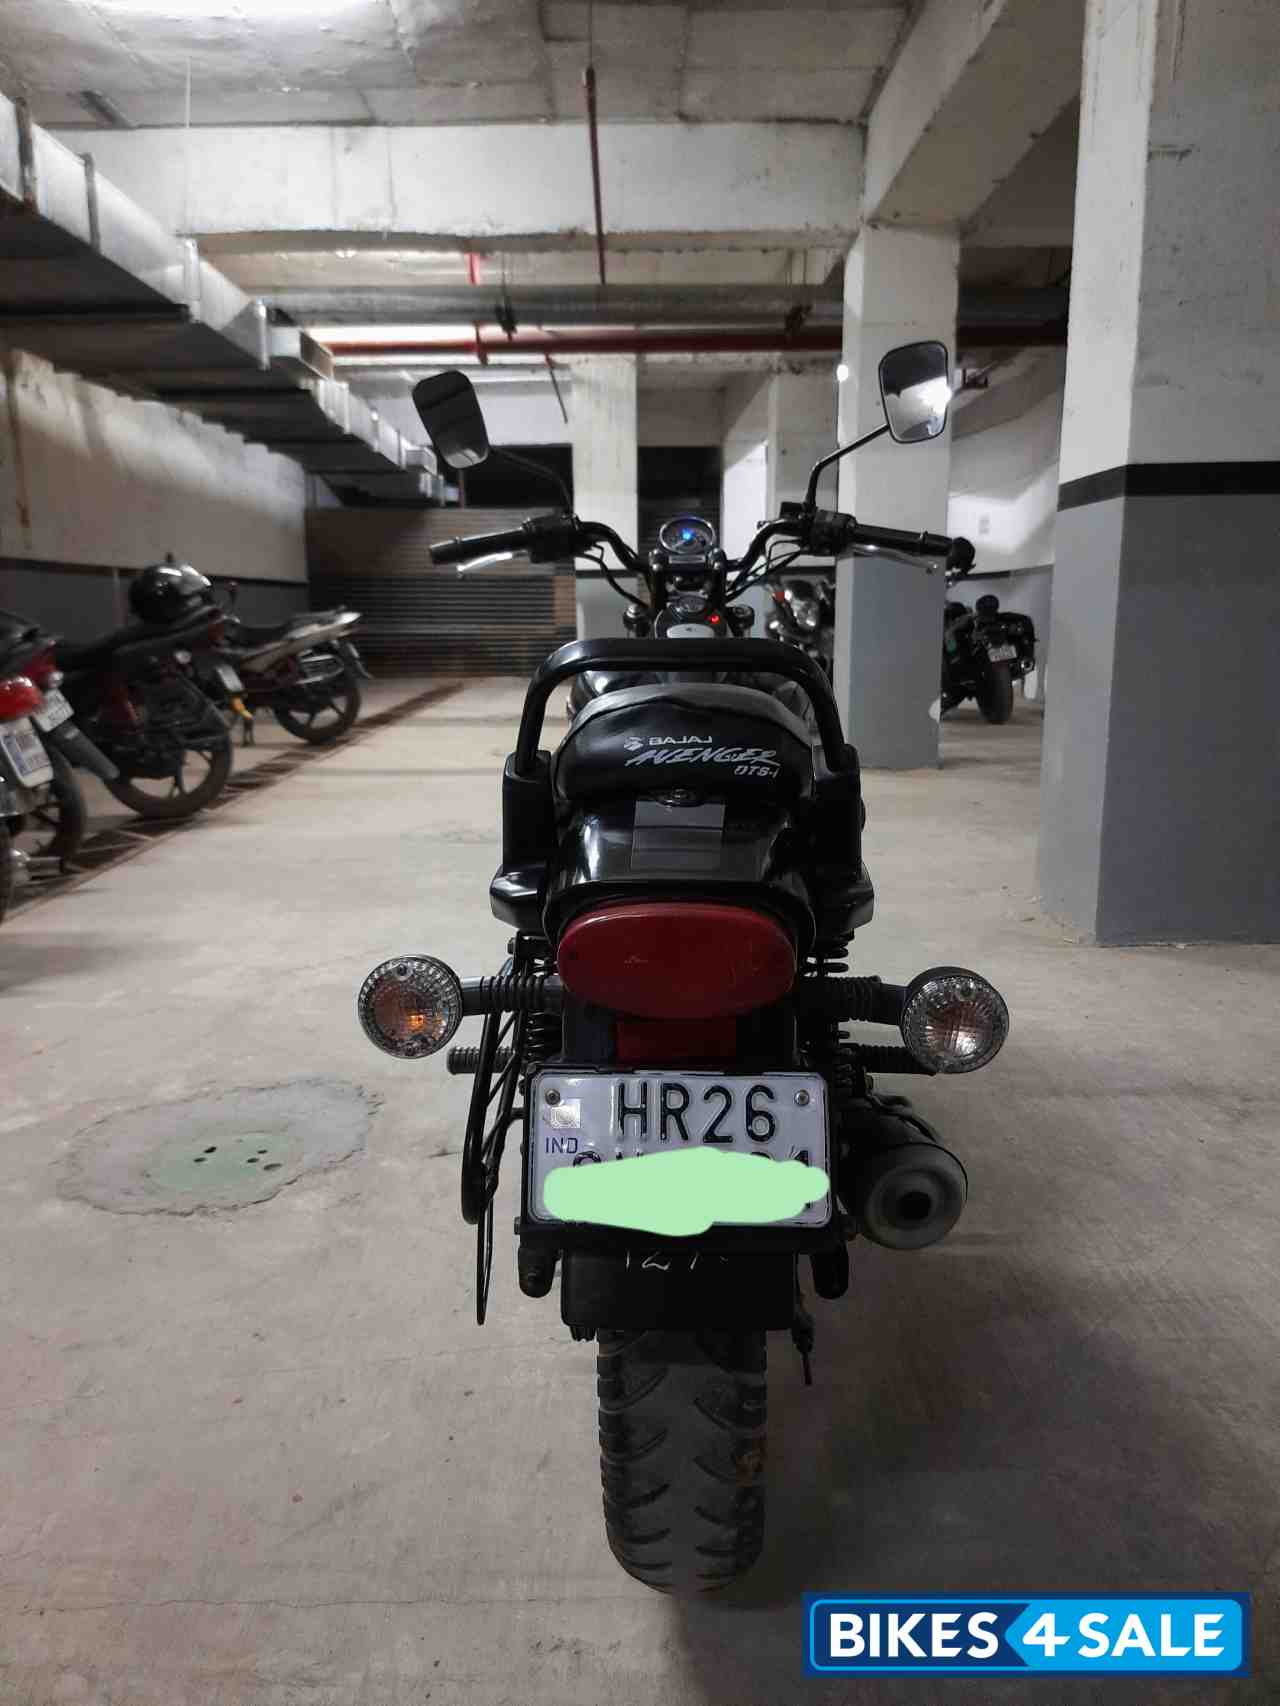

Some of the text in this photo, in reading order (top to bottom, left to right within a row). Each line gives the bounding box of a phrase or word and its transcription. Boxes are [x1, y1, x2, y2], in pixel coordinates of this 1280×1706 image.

[649, 735, 713, 746] BAJAJ
[625, 747, 780, 767] AVENGER
[617, 1082, 776, 1143] HR26
[545, 1137, 578, 1154] IND
